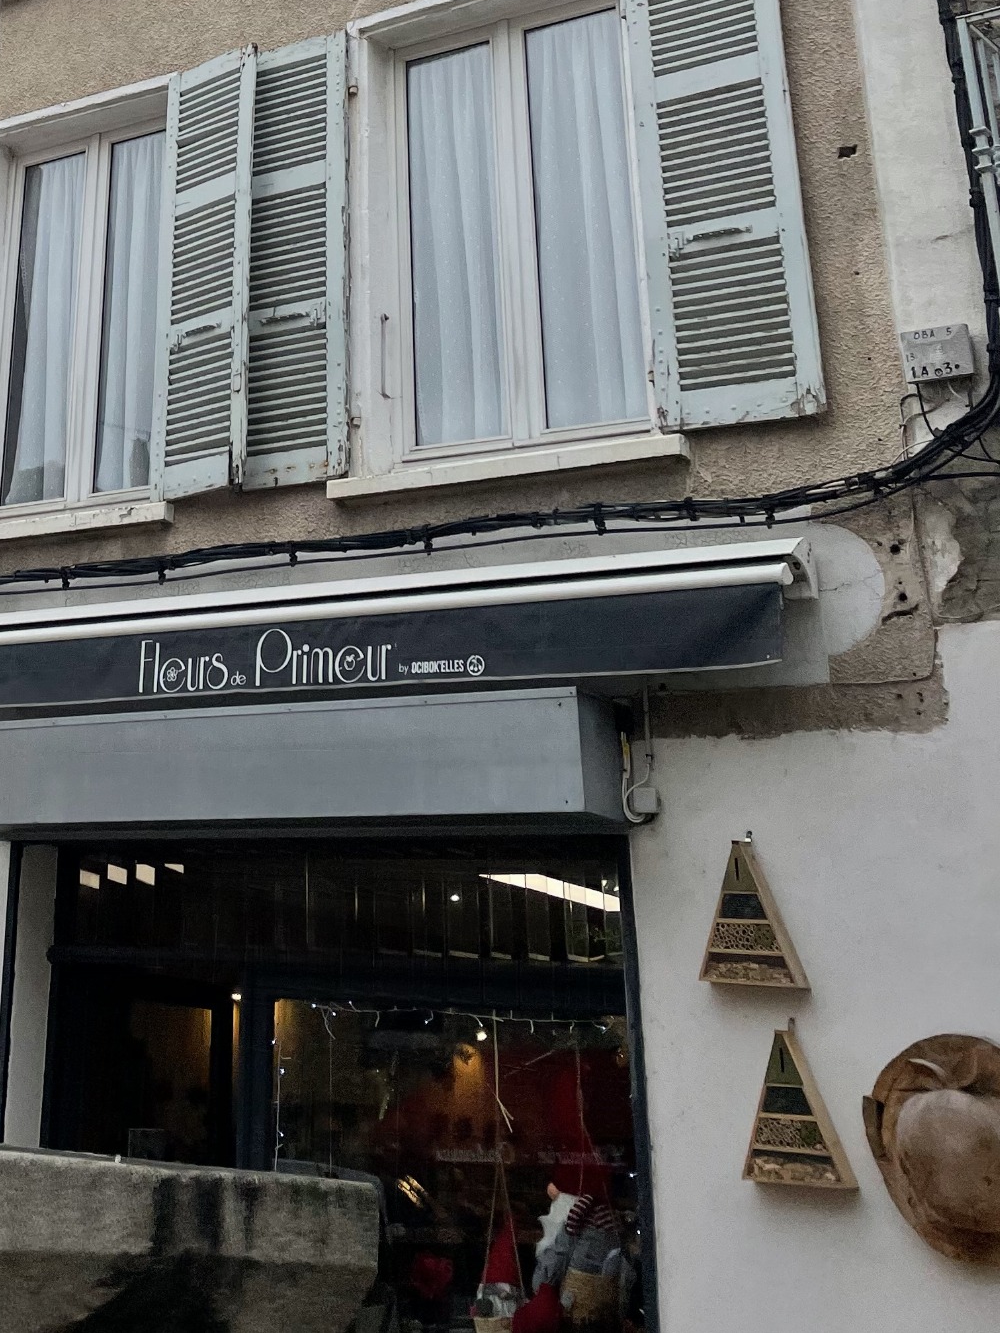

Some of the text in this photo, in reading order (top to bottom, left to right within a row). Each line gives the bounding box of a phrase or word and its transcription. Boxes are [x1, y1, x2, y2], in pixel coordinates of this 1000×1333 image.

[138, 639, 229, 694] Fleurs
[230, 671, 247, 687] de
[255, 628, 392, 687] Primeur
[398, 662, 409, 676] by
